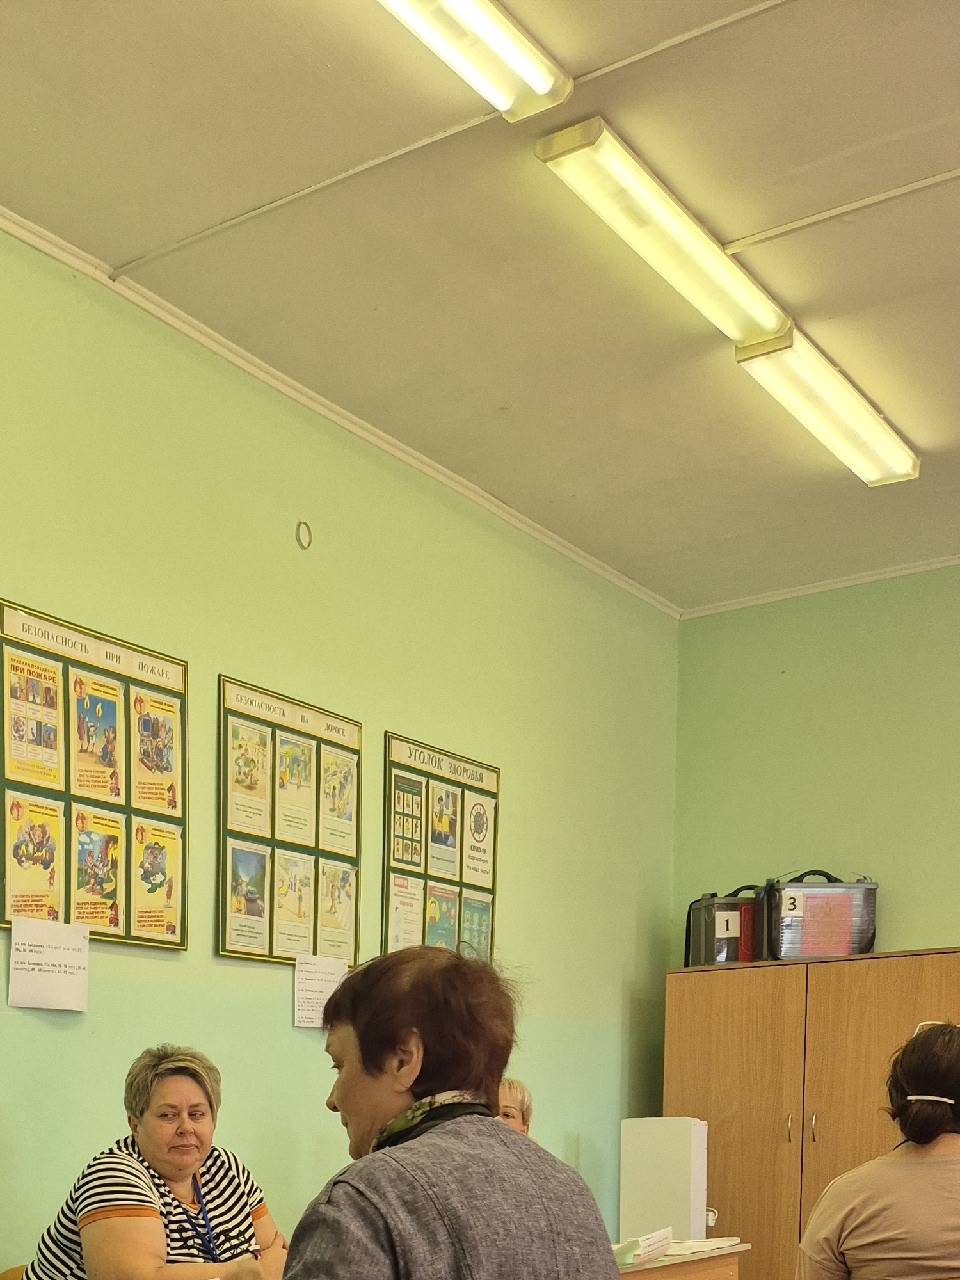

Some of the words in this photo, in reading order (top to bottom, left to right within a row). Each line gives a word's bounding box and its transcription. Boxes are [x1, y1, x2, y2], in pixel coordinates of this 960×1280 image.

[21, 622, 89, 655] БЕЗОПАСНОСТЬ
[105, 650, 121, 665] ПРИ
[138, 661, 171, 680] ПОЖАРЕ
[10, 663, 25, 675] ПРИ
[26, 668, 57, 684] ПОЖАРЕ
[235, 693, 286, 718] БЕЗОПАСНОСТЬ
[300, 713, 309, 725] НА
[324, 721, 346, 738] ДОРОГЕ
[407, 746, 444, 771] УГОЛОК
[448, 761, 485, 784] ЗДОРОВЬЯ
[787, 896, 798, 912] 3
[723, 917, 731, 933] 1
